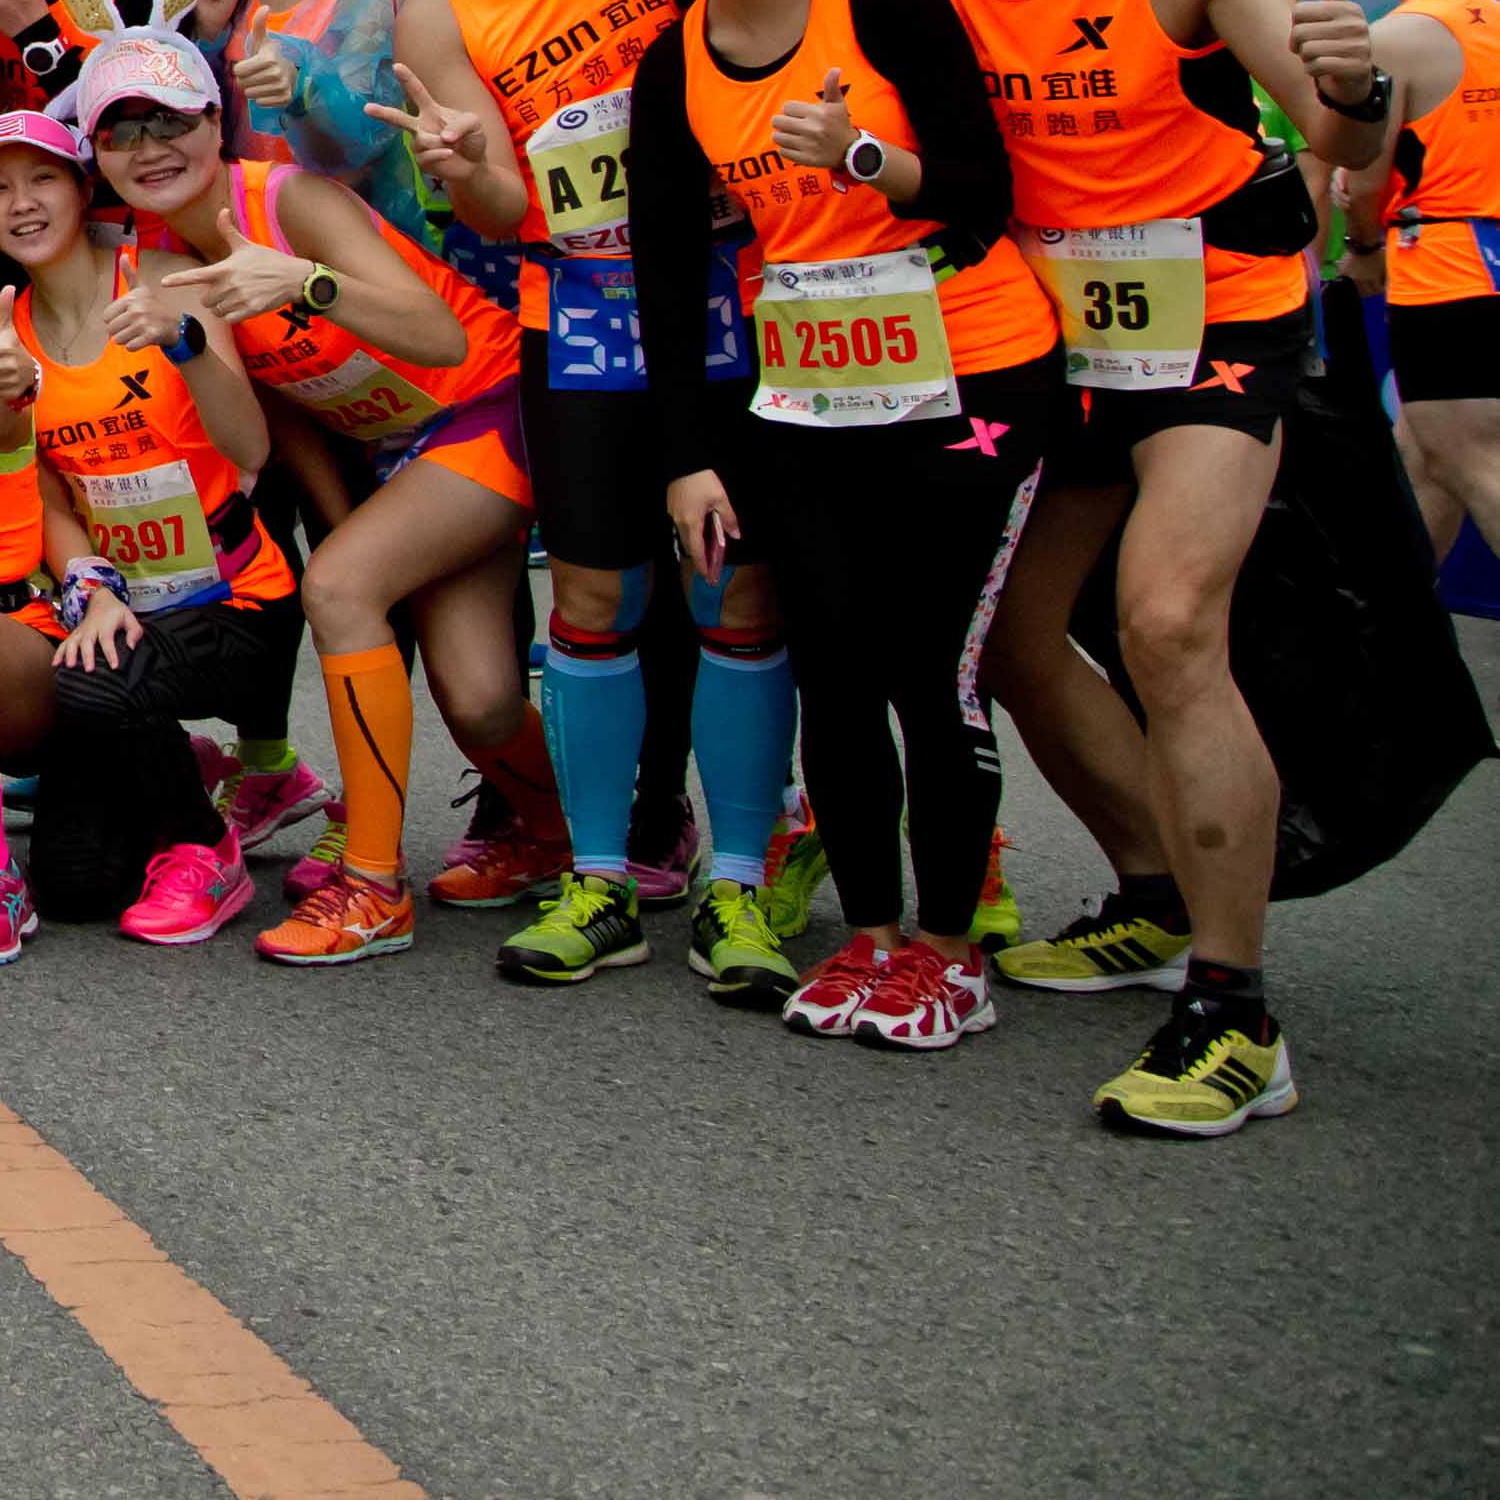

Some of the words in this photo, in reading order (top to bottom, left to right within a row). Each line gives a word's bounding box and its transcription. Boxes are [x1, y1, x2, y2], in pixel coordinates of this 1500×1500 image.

[493, 18, 599, 100] EZON
[988, 70, 1031, 101] ON
[1041, 68, 1117, 101] 宜准
[1007, 109, 1123, 137] 领跑员
[546, 165, 582, 215] A
[745, 173, 822, 211] 方领跑
[562, 229, 632, 252] EZO
[1083, 280, 1150, 331] 35
[763, 320, 786, 368] A
[795, 314, 918, 369] 2505
[99, 410, 148, 438] 宜准
[94, 514, 186, 563] 2397
